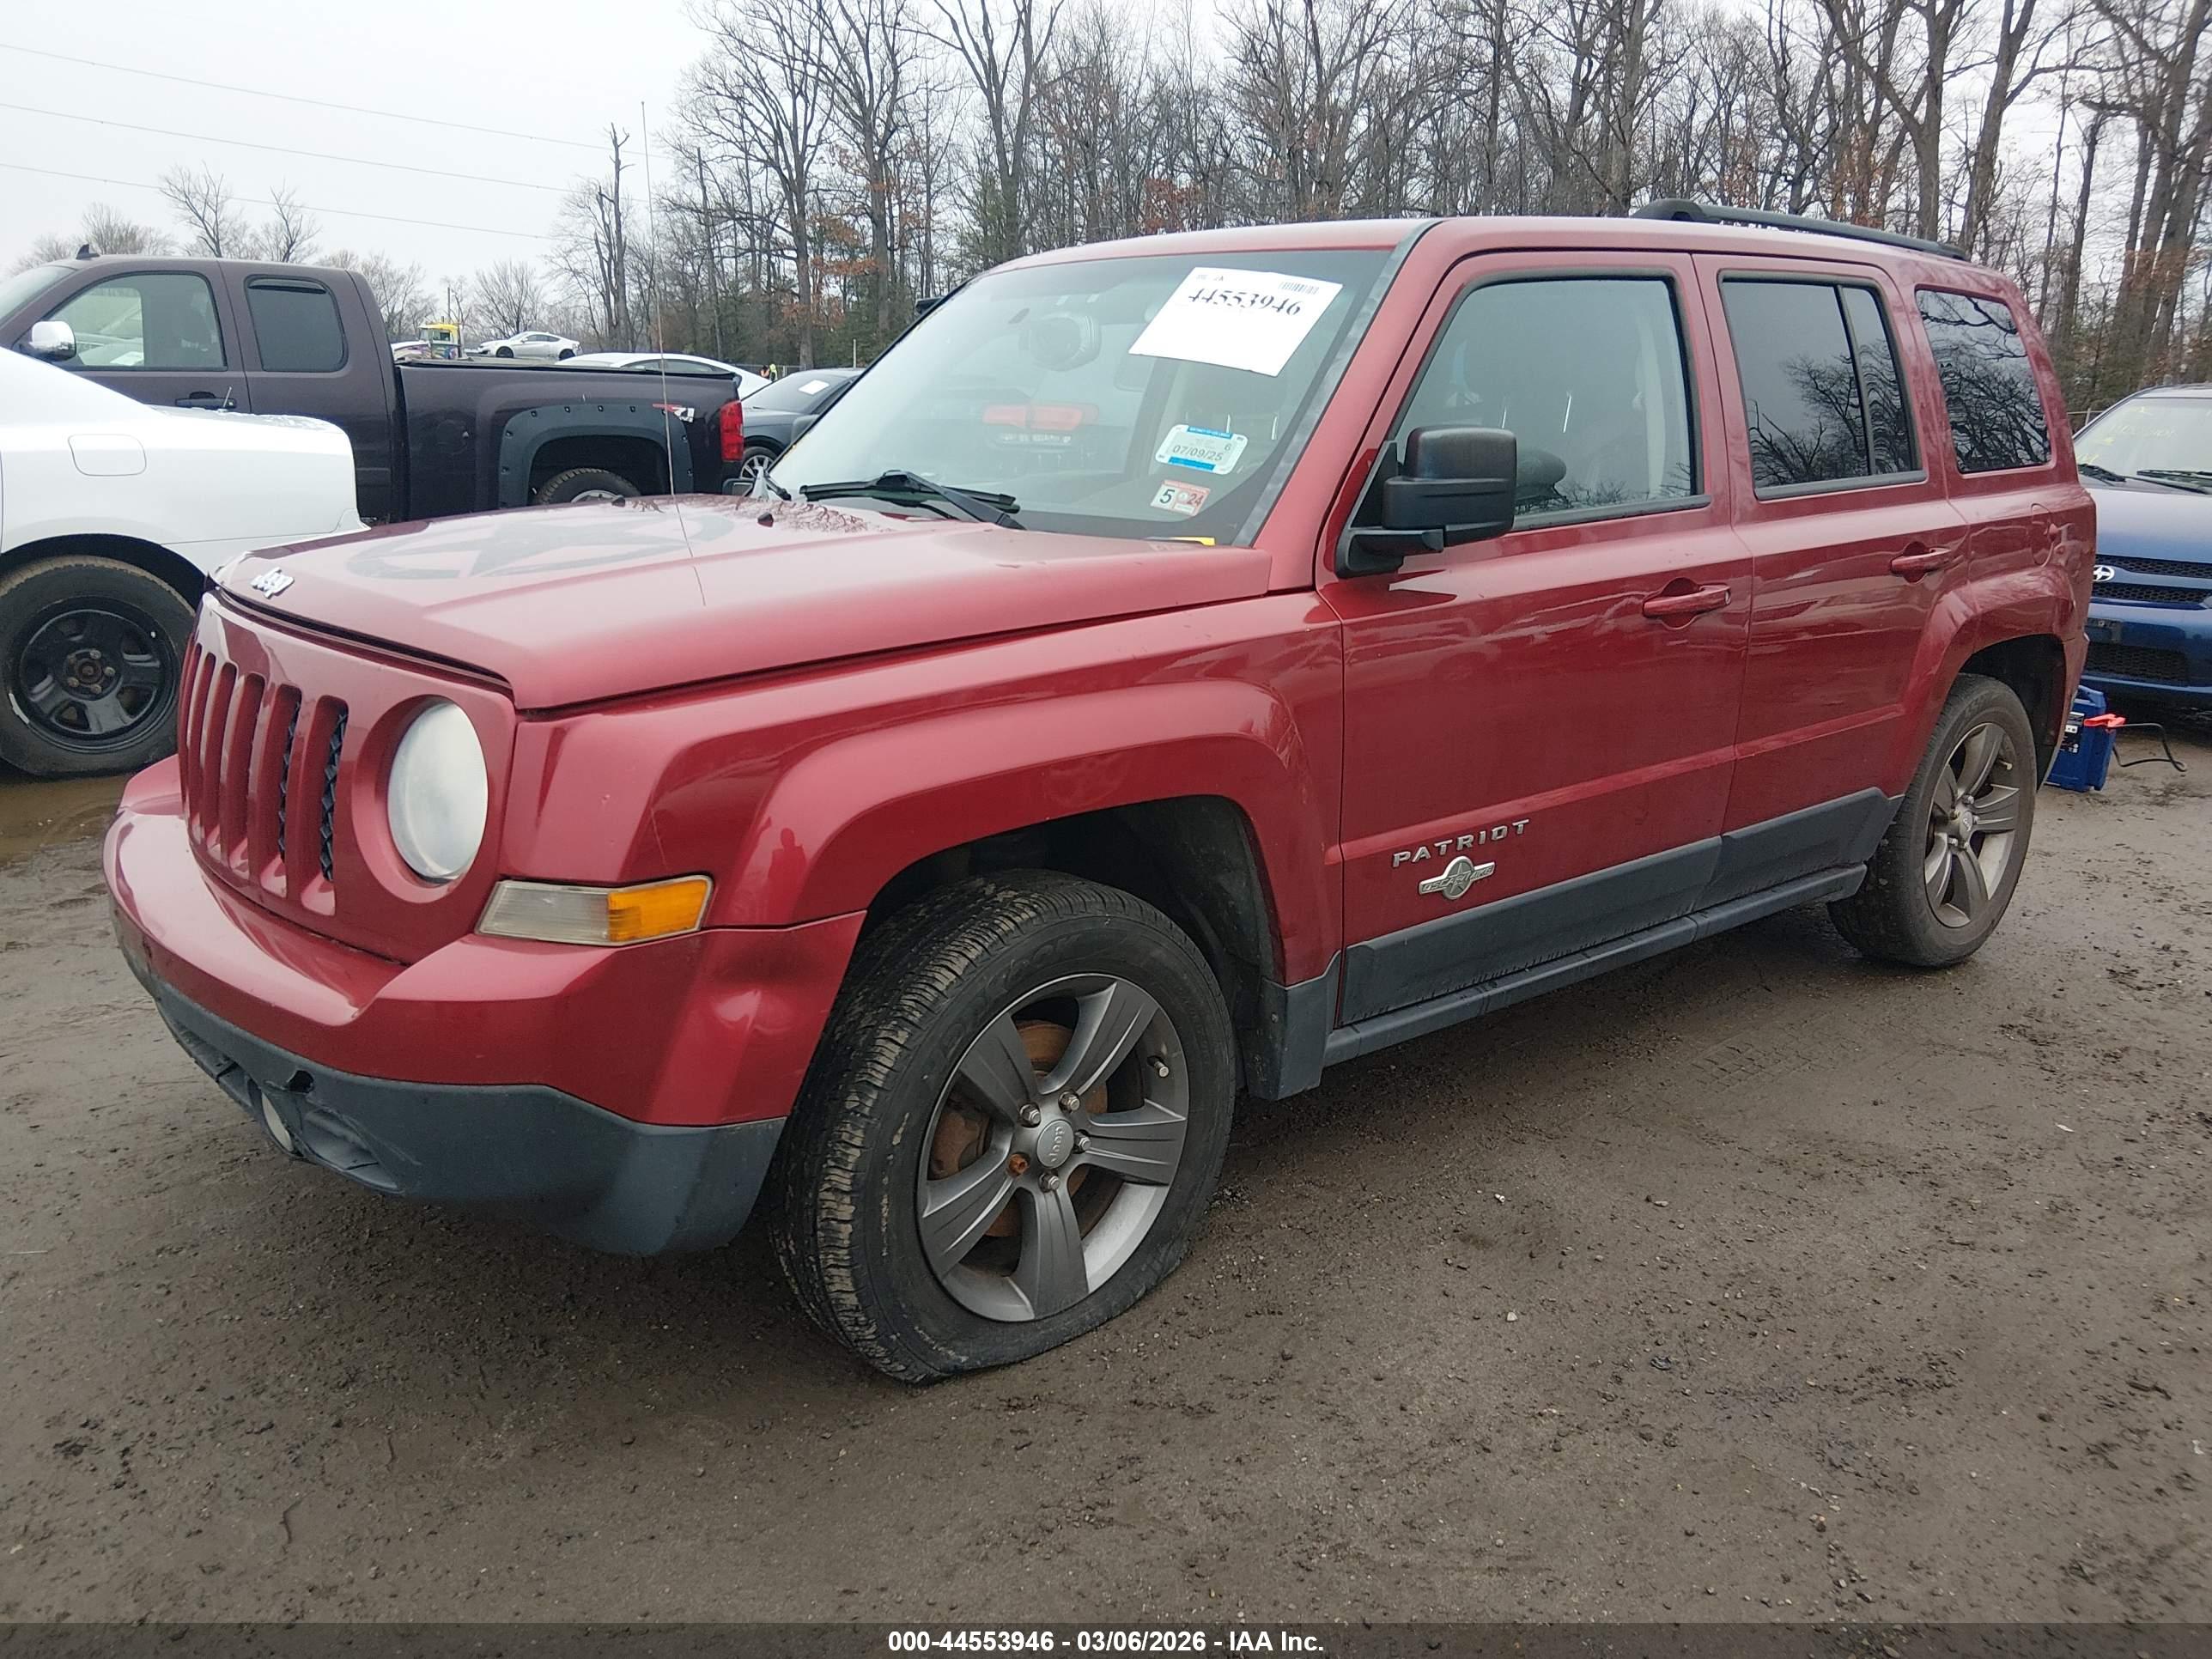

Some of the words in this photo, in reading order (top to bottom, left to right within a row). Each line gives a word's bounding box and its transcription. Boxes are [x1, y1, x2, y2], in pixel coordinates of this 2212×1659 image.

[1188, 287, 1302, 316] 44553946
[1172, 444, 1224, 462] 07/09/25
[1159, 489, 1176, 505] 5
[1187, 492, 1204, 507] 24
[1392, 818, 1530, 868] PATRIOT
